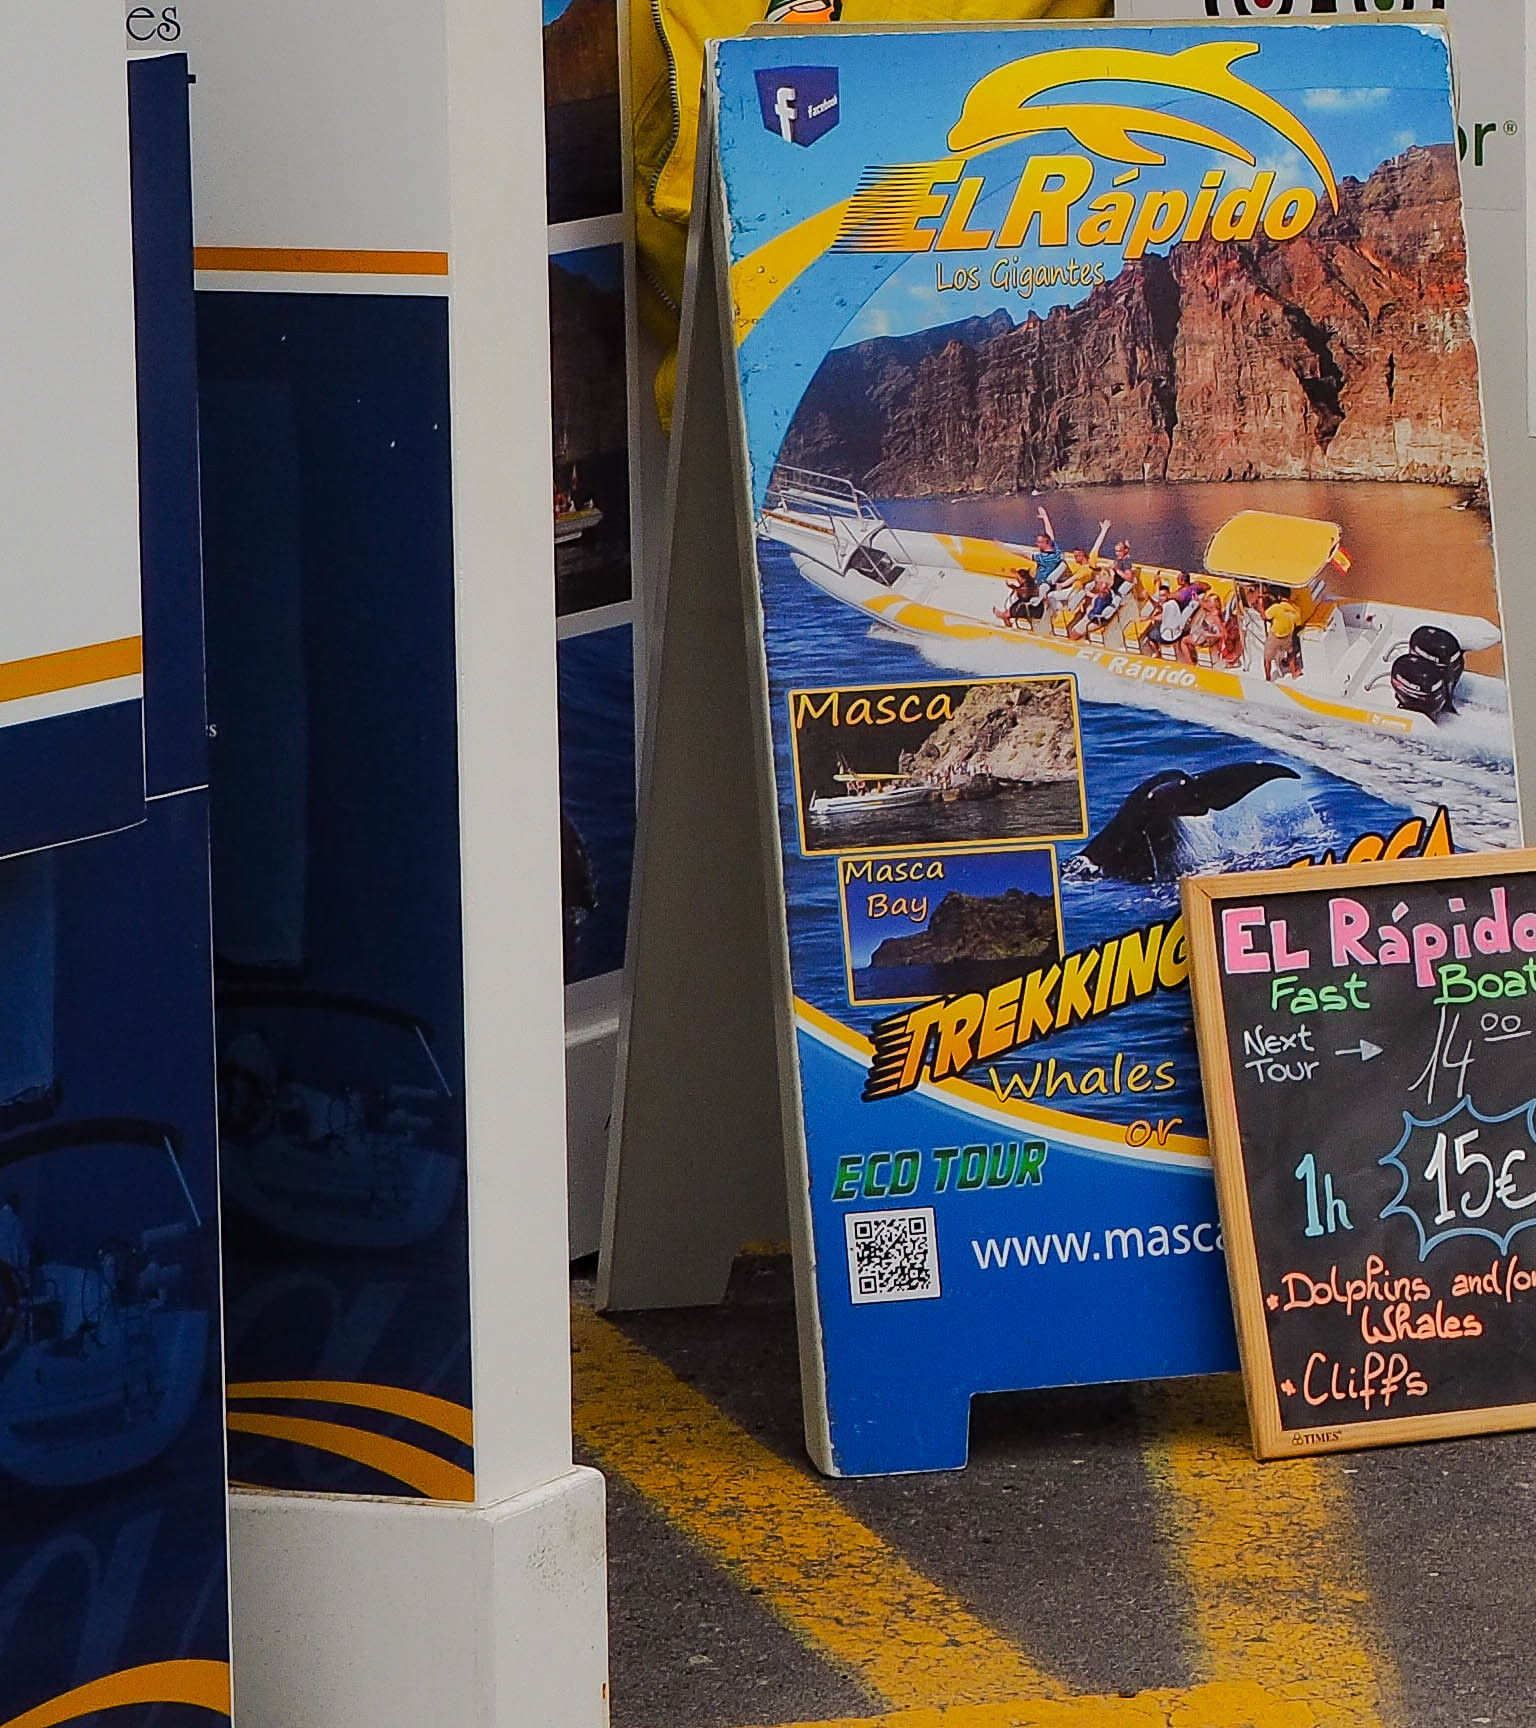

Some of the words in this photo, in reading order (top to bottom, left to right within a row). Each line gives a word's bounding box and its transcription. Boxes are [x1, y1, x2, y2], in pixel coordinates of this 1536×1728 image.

[996, 155, 1318, 261] Rápido
[936, 261, 978, 292] Los
[991, 258, 1106, 298] Gigantes
[793, 688, 955, 729] Masca
[844, 858, 944, 883] Masca
[867, 892, 929, 925] Bay
[1270, 973, 1373, 1015] Fast
[988, 1052, 1176, 1104] Whales
[1125, 1115, 1182, 1149] or
[832, 1150, 924, 1203] ECO
[934, 1140, 1045, 1193] TOUR
[1294, 1152, 1355, 1239] 1h
[1360, 1301, 1484, 1345] Whales
